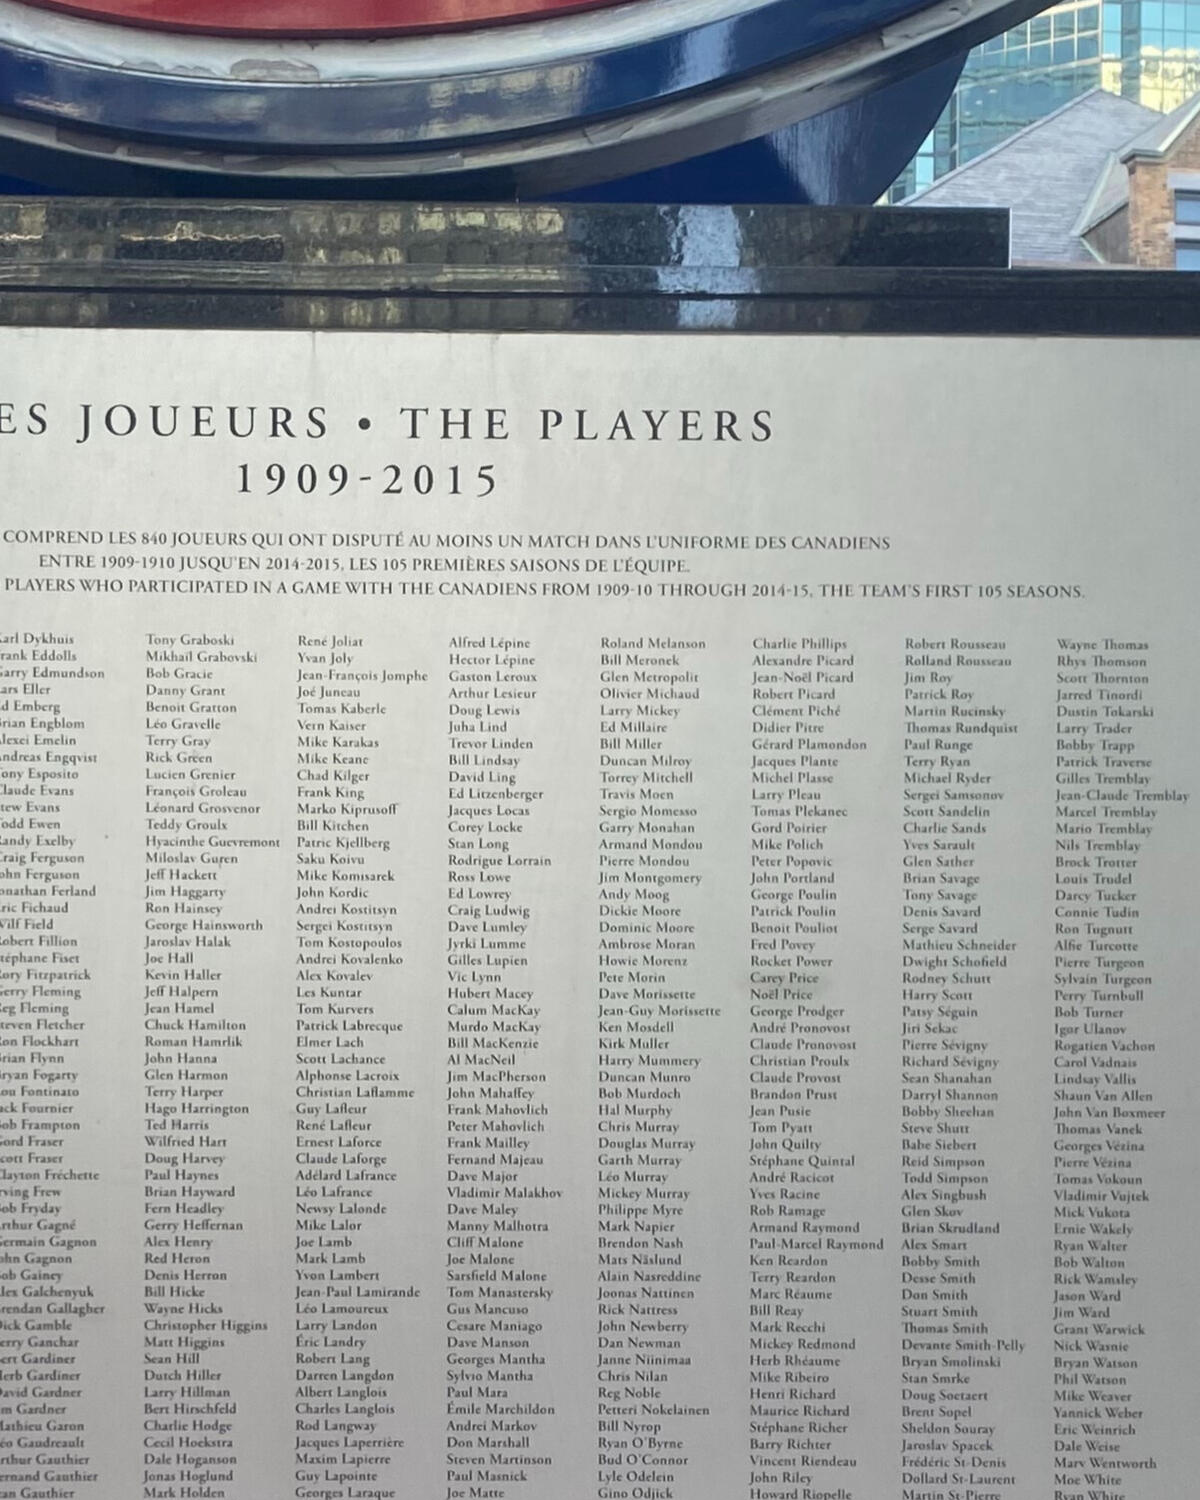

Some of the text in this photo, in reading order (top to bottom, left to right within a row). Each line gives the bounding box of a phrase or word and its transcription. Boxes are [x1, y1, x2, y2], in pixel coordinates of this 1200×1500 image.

[75, 403, 327, 444] JOUEURS
[399, 407, 510, 440] THE
[539, 408, 772, 443] PLAYERS
[237, 462, 495, 498] 1909-2015
[2, 529, 104, 545] COMPREND
[108, 530, 137, 545] LES
[140, 531, 168, 546] 840
[169, 531, 248, 549] JOUEURS
[251, 532, 284, 551] QUI
[287, 532, 328, 547] ONT
[331, 530, 405, 548] DISPUTÉ
[408, 533, 431, 548] AU
[435, 533, 493, 549] MOINS
[498, 534, 524, 549] UN
[527, 534, 590, 549] MATCH
[595, 535, 642, 549] DANS
[646, 535, 750, 550] L'UNIFORME
[755, 535, 787, 550] DES
[791, 535, 891, 551] CANADIENS
[39, 553, 97, 569] ENTRE
[101, 555, 176, 570] 1909-1910
[178, 555, 261, 573] JUSQU'EN
[349, 557, 378, 572] LES
[382, 557, 408, 572] 105
[412, 554, 506, 572] PREMIÈRES
[509, 558, 580, 573] SAISONS
[585, 558, 609, 573] DE
[4, 577, 76, 593] PLAYERS
[78, 578, 124, 593] WHO
[128, 578, 249, 594] PARTICIPATED
[253, 580, 272, 594] IN
[276, 580, 288, 595] A
[291, 580, 342, 595] GAME
[344, 580, 393, 596] WITH
[397, 581, 435, 596] THE
[438, 581, 538, 596] CANADIENS
[542, 582, 590, 597] FROM
[597, 583, 653, 597] 1909-10
[657, 583, 747, 597] THROUGH
[821, 583, 853, 598] THE
[860, 583, 921, 598] TEAM'S
[925, 584, 973, 598] FIRST
[978, 584, 1003, 598] 105
[752, 637, 847, 653] Charlie Phillips
[449, 653, 536, 669] Hector Lépine
[951, 688, 973, 703] Roy
[1056, 704, 1154, 718] Dustin Tokarski
[297, 735, 379, 748] Mike Karakas
[145, 750, 213, 764] Rick Green
[750, 754, 839, 771] Jacques Plante
[447, 903, 530, 920] Craig Ludwig
[902, 922, 978, 938] Serge Savard
[1055, 955, 1145, 972] Pierre Turgeon
[749, 971, 819, 987] Carey Price
[36, 1018, 85, 1031] Fletcher
[295, 1102, 367, 1118] Guy Lafleur
[447, 1119, 545, 1132] Peter Mahovlich
[597, 1120, 678, 1136] Chris Murray
[900, 1121, 970, 1134] Steve Shutt
[144, 1152, 224, 1168] Doug Harvey
[19, 1268, 63, 1284] Gainey
[143, 1318, 268, 1335] Christopher Higgins
[750, 1404, 850, 1417] Maurice Richard
[294, 1435, 340, 1452] Jacques
[446, 1452, 552, 1465] Steven Martinson
